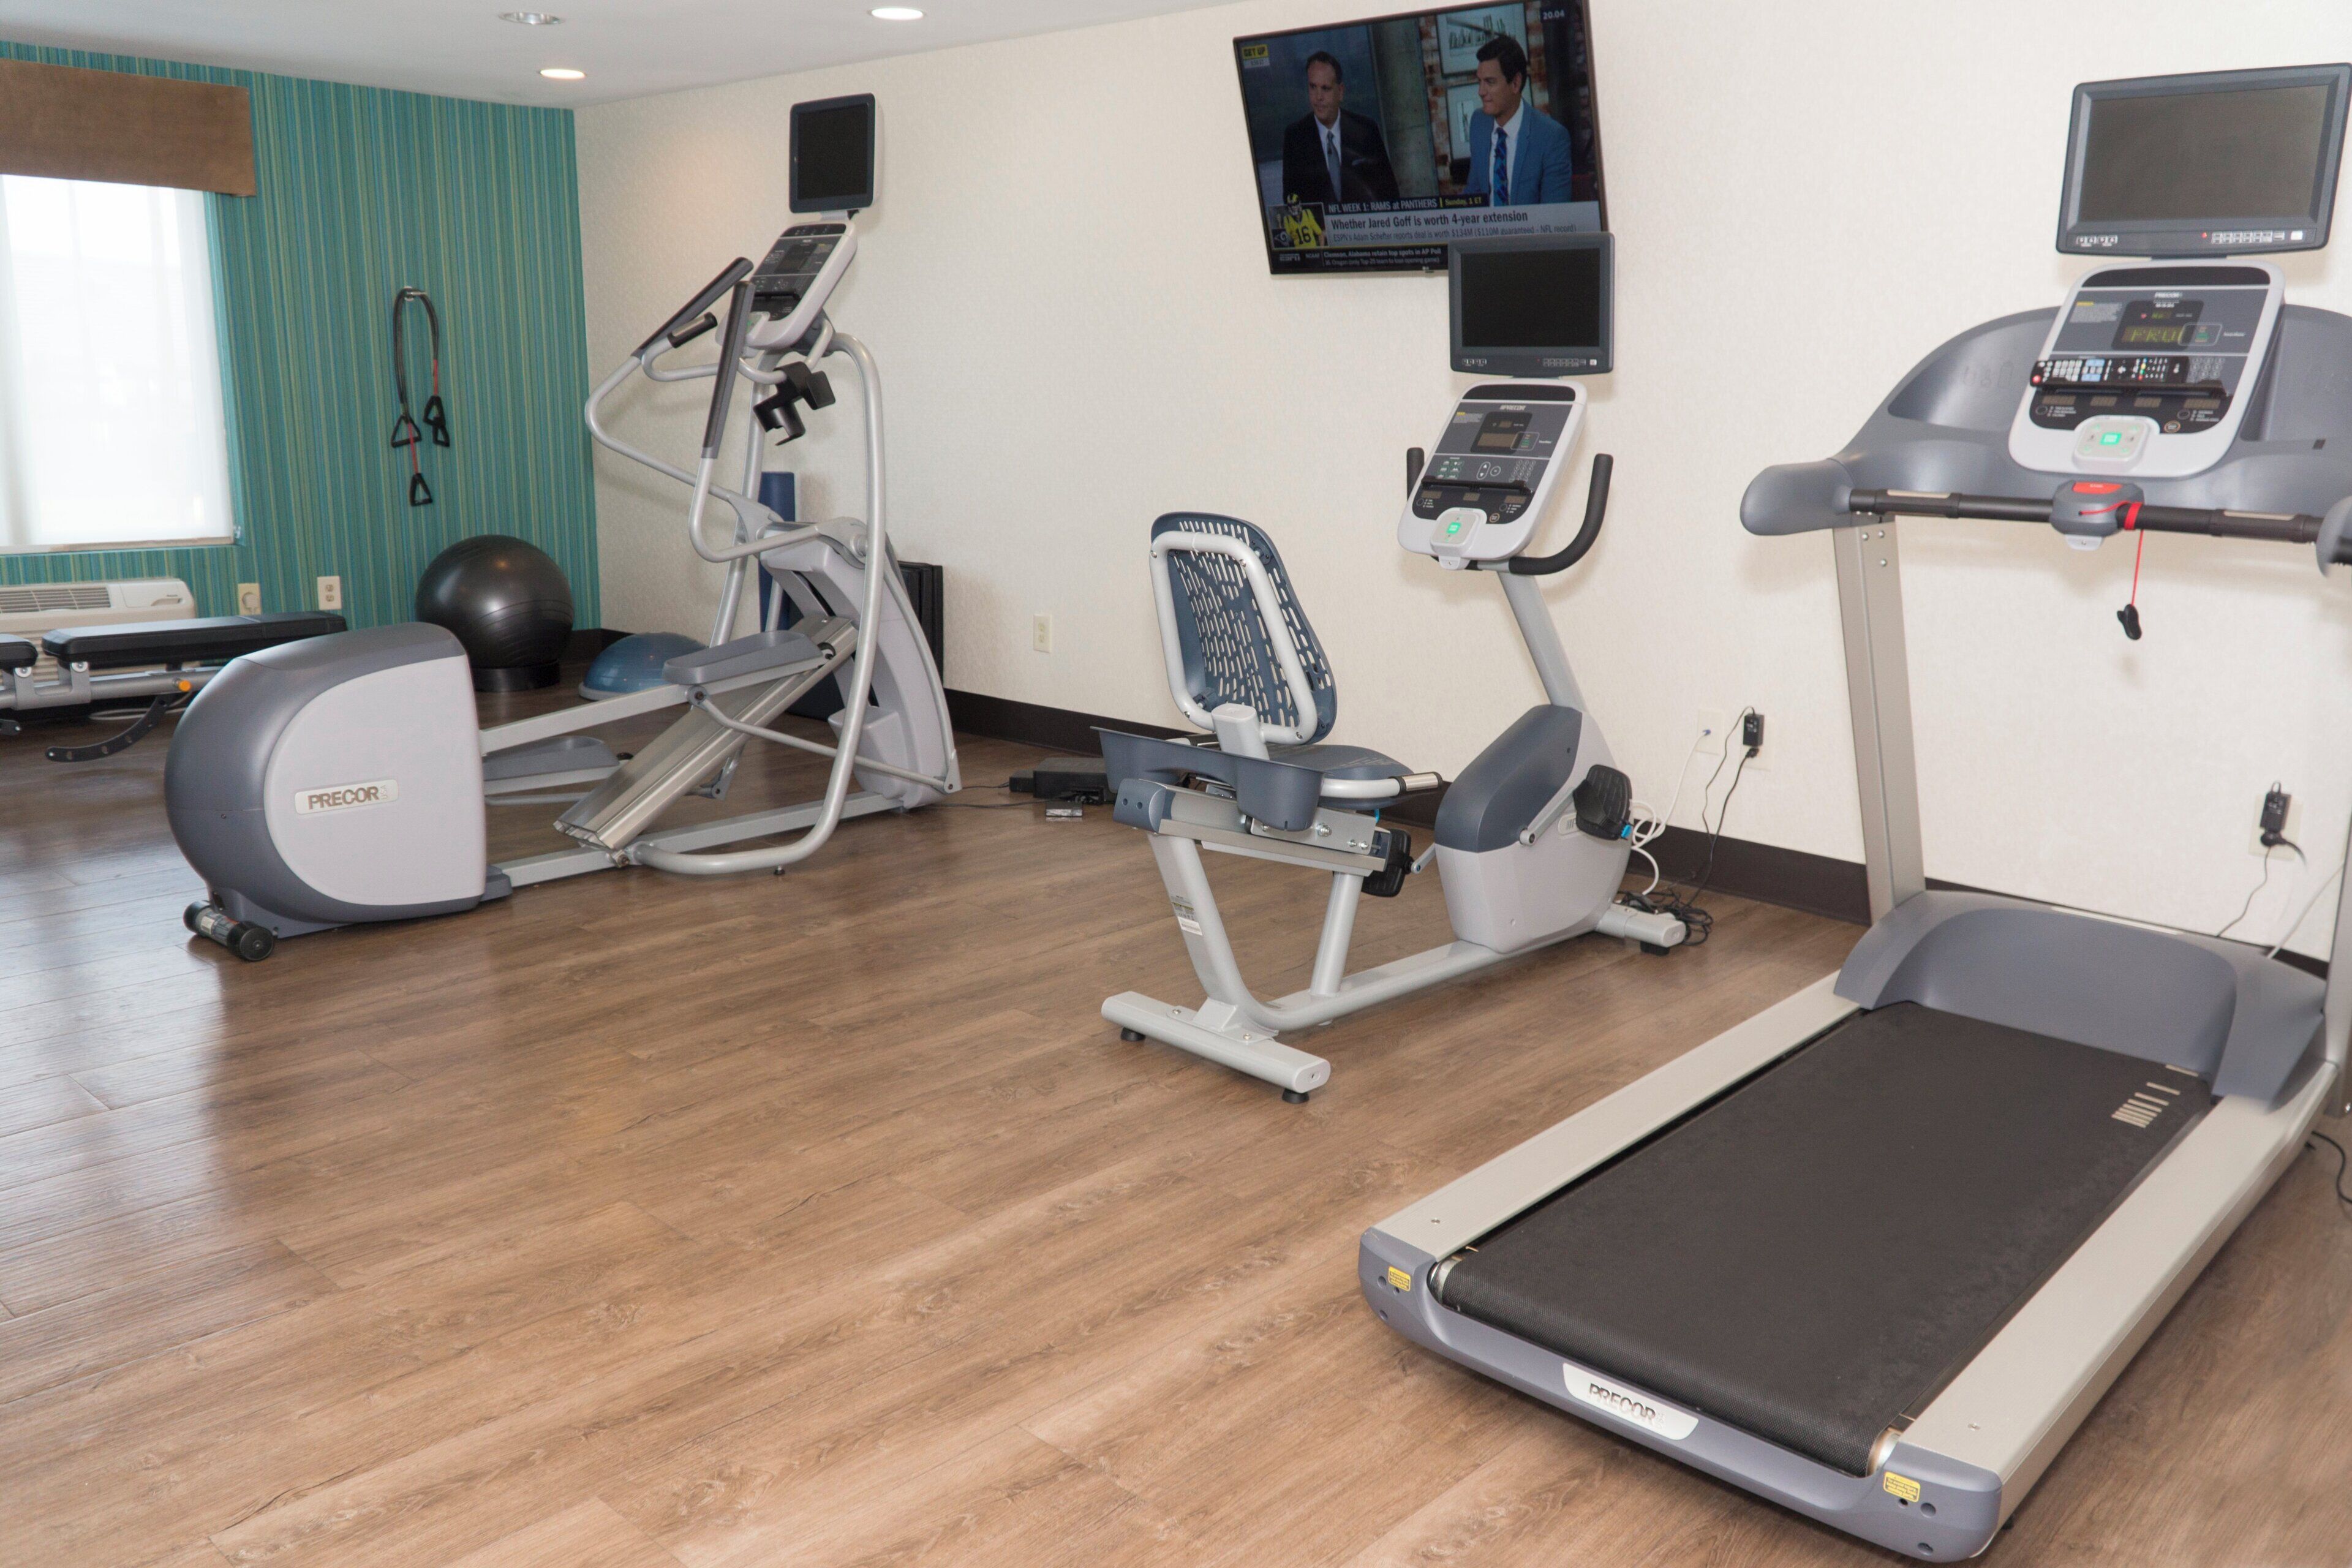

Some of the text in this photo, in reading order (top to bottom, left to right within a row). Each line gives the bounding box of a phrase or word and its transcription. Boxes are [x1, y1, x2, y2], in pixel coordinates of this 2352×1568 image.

[1329, 204, 1341, 213] NFL
[1342, 203, 1361, 213] WEEK
[1363, 203, 1370, 211] 1:
[1371, 202, 1390, 211] RAMS
[1401, 199, 1437, 209] PANTHERS
[1331, 210, 1528, 230] Whether Jared Goff is worth 4-year extension
[1296, 226, 1311, 244] 16
[1393, 232, 1412, 240] reports
[1414, 230, 1426, 238] deal
[1434, 229, 1449, 238] worth
[1452, 228, 1472, 238] $134M
[1474, 227, 1499, 237] ($110M
[307, 786, 379, 809] PRECOR
[1588, 1382, 1656, 1425] PRECOR
